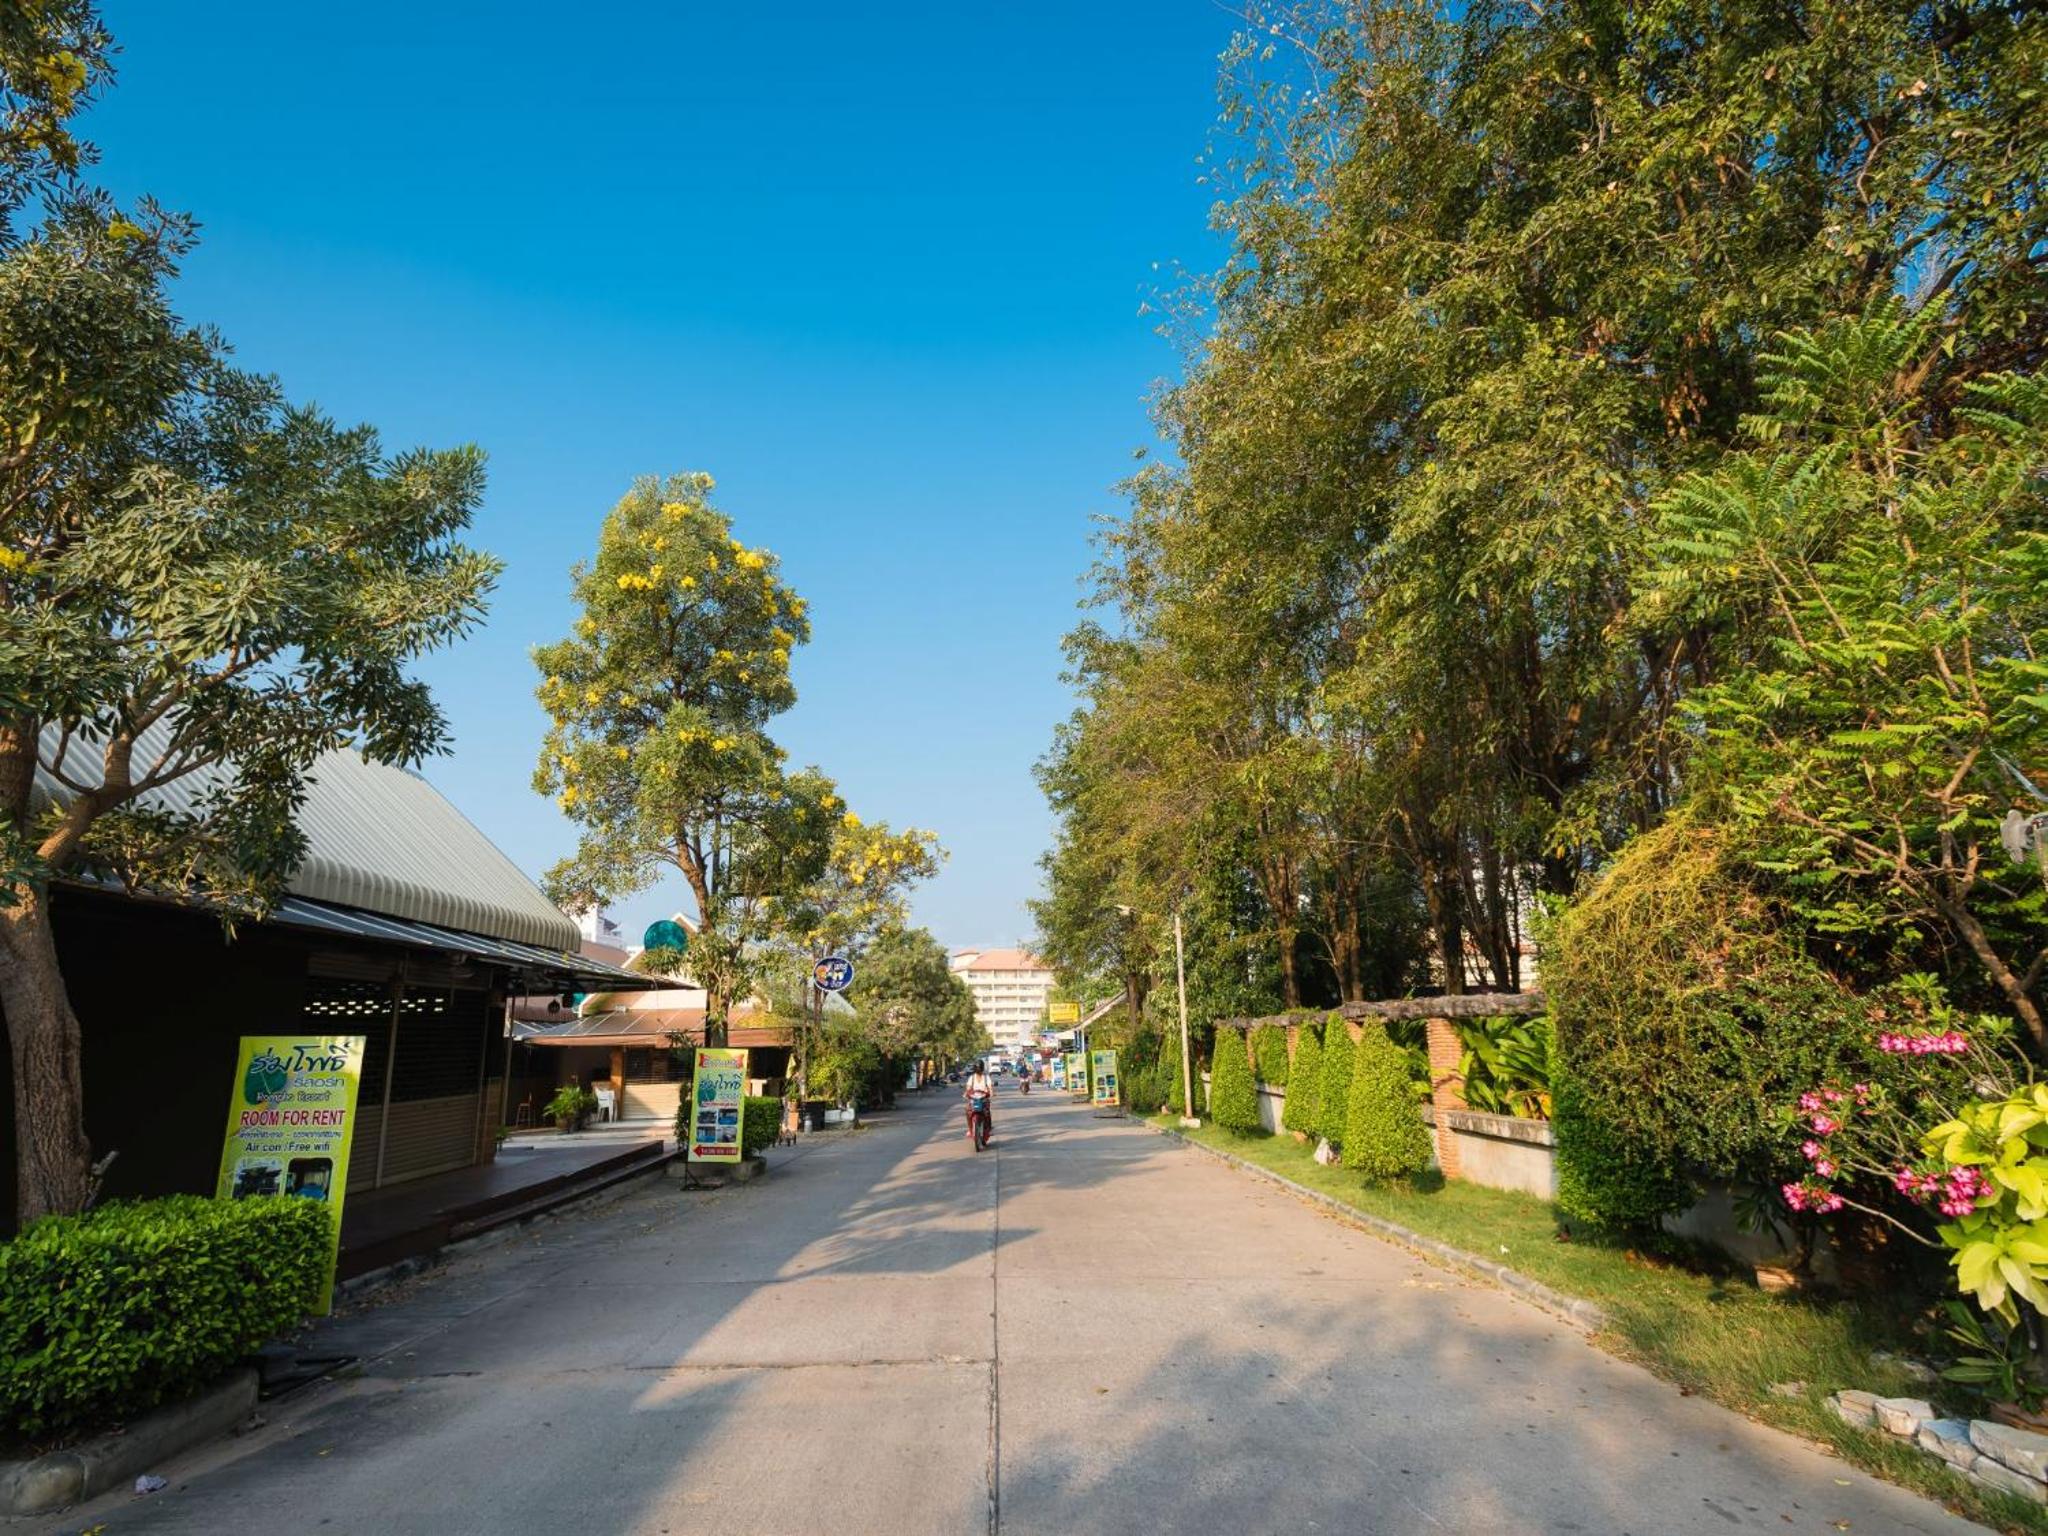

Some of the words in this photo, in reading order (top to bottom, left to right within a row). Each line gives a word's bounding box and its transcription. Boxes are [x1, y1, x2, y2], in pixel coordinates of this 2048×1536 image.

[240, 1110, 279, 1126] ROOM
[282, 1110, 309, 1126] FOR
[312, 1110, 346, 1126] RENT
[246, 1142, 260, 1152] Air
[289, 1142, 311, 1152] Free
[313, 1142, 330, 1151] wifi
